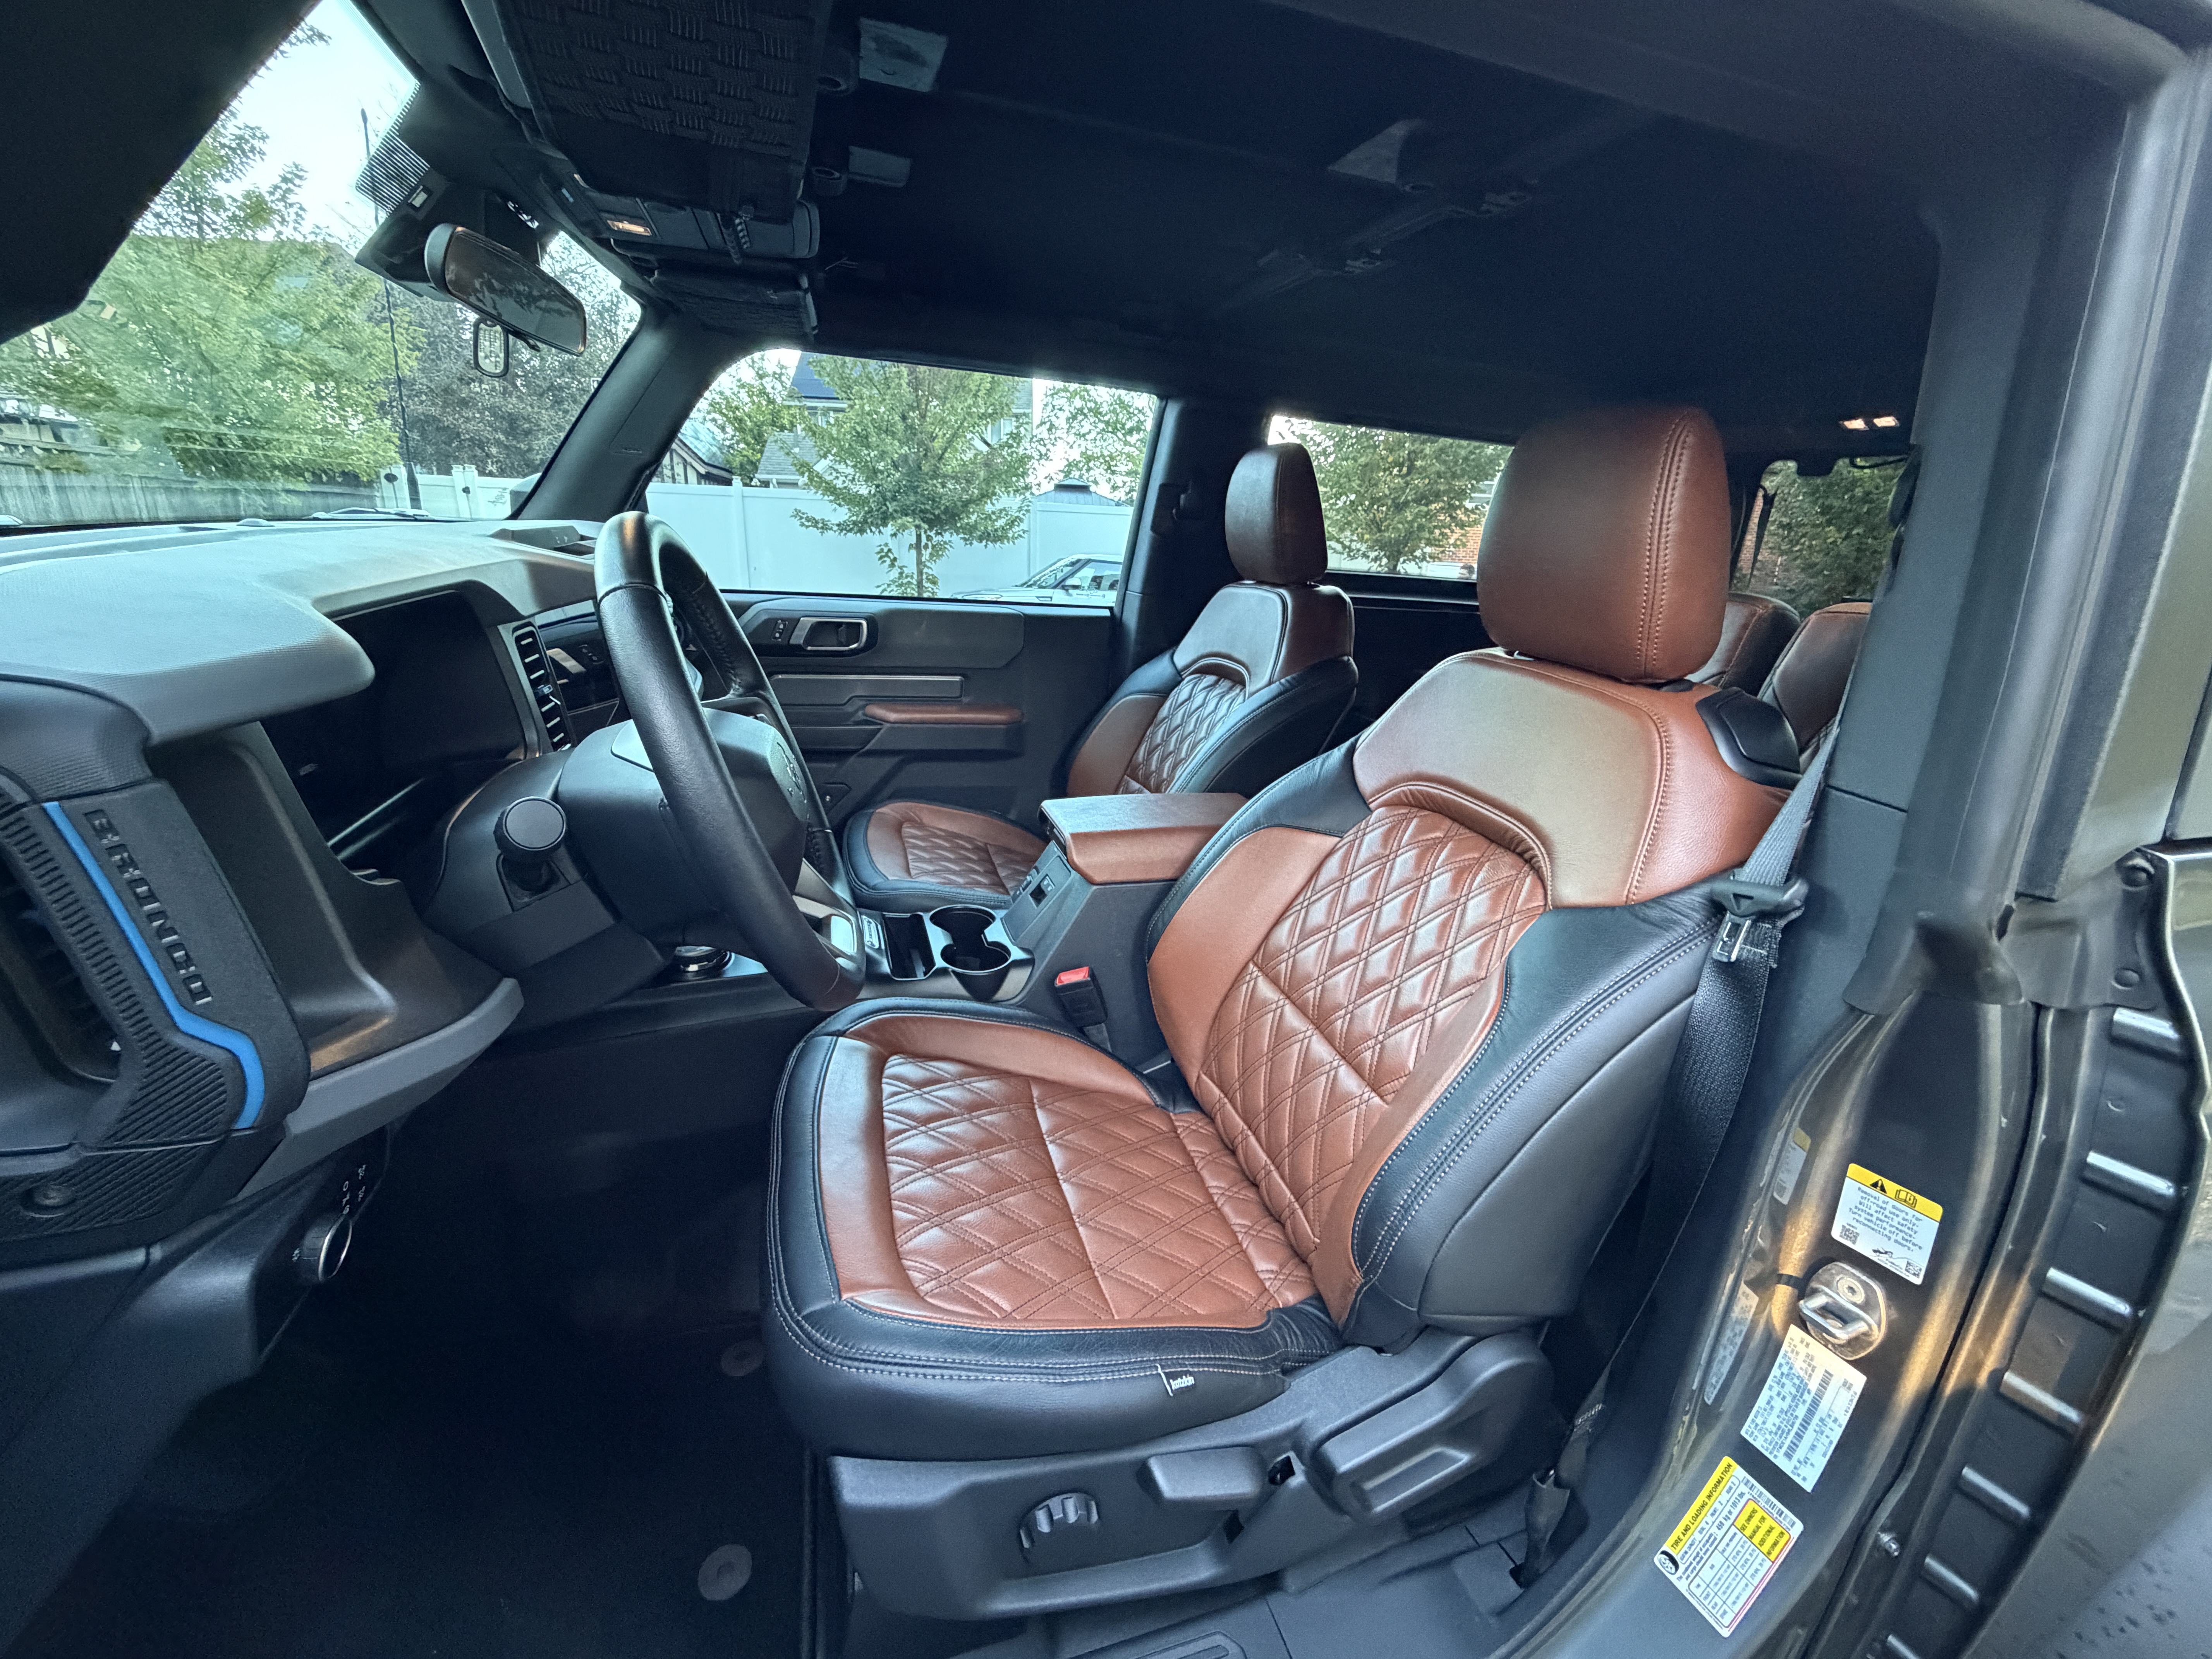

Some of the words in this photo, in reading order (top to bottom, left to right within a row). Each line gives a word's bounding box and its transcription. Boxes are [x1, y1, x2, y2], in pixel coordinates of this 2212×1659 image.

[84, 809, 212, 1005] BRONCO
[1857, 1186, 1879, 1201] Removal
[1891, 1205, 1908, 1216] doors
[1860, 1195, 1887, 1211] off-road
[1889, 1210, 1899, 1218] use
[1849, 1207, 1862, 1218] Turn
[1864, 1217, 1887, 1231] vehicle
[1901, 1235, 1922, 1250] before
[1852, 1217, 1891, 1241] reconnecting
[1854, 1205, 1873, 1218] system
[1875, 1216, 1915, 1239] performance.
[1858, 1200, 1871, 1210] Will
[1874, 1209, 1894, 1222] affect
[1897, 1221, 1918, 1235] safety
[1671, 1535, 1683, 1550] TIRE
[1681, 1524, 1691, 1537] AND
[1688, 1500, 1708, 1525] LOADING
[1705, 1462, 1732, 1501] INFORMATION
[1730, 1497, 1740, 1510] 1013
[1758, 1515, 1767, 1525] FOR
